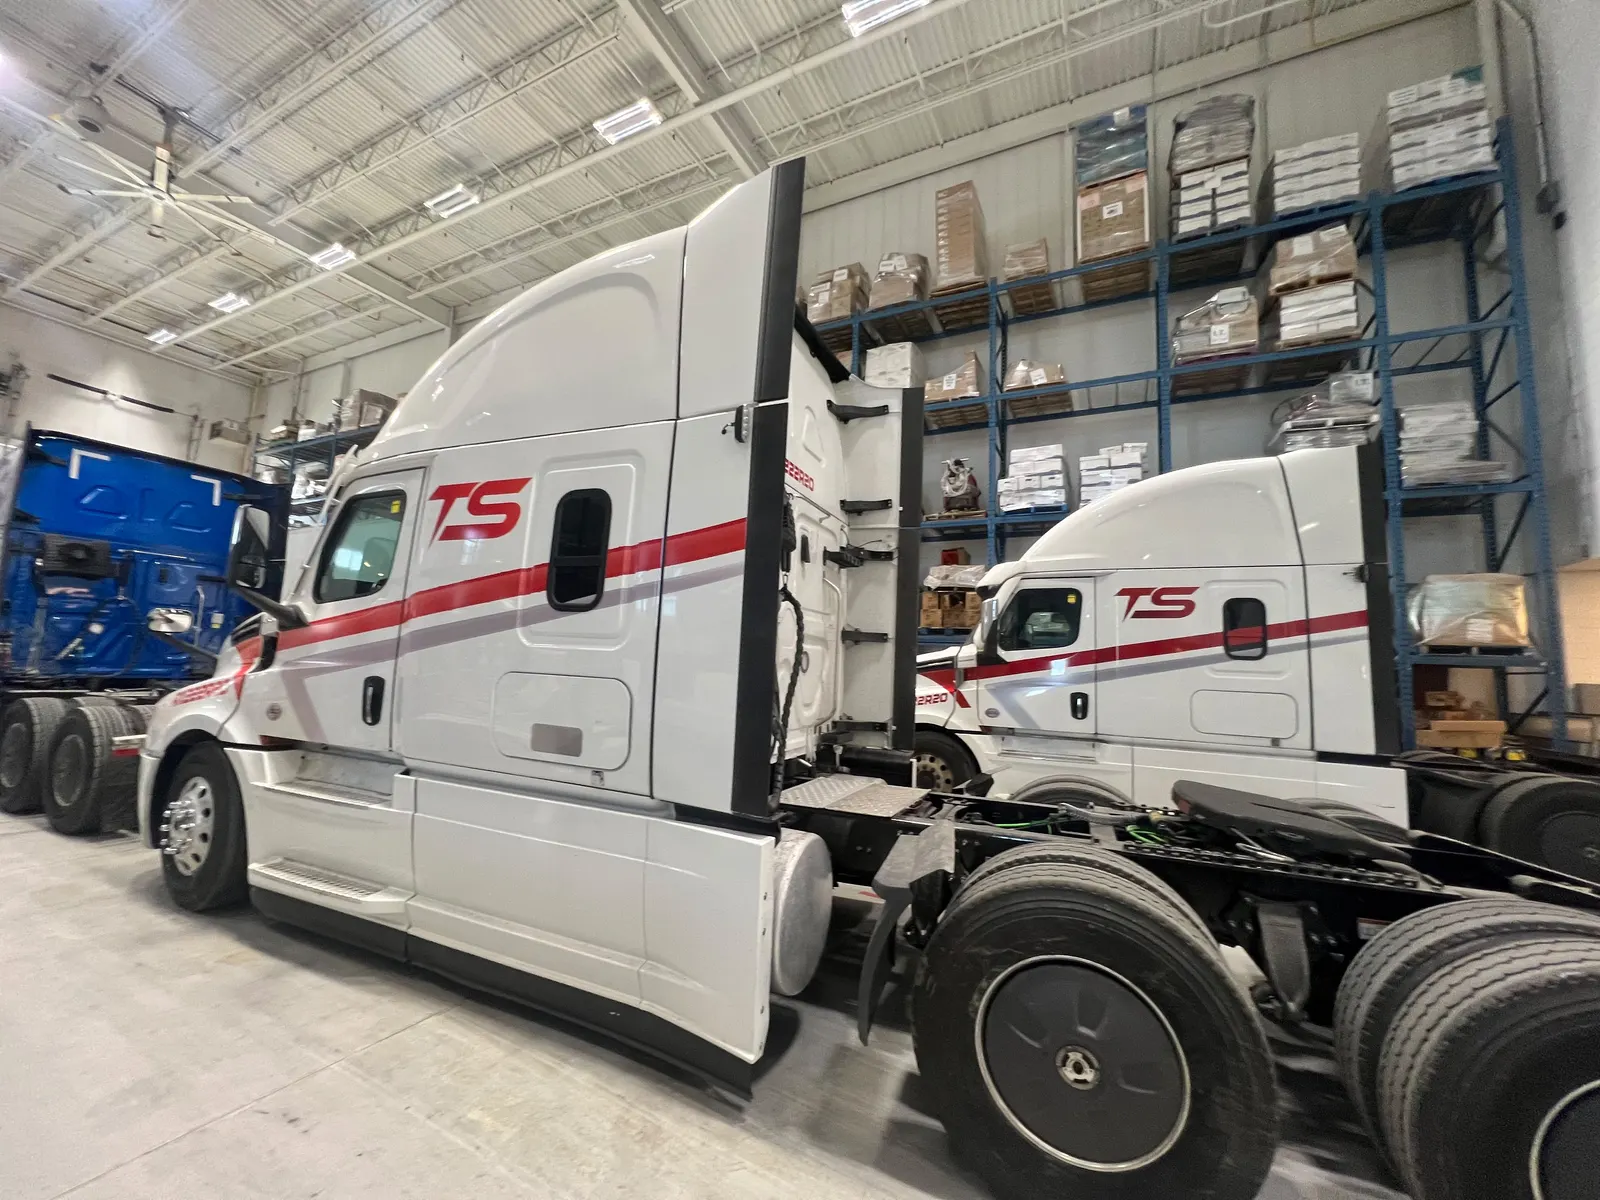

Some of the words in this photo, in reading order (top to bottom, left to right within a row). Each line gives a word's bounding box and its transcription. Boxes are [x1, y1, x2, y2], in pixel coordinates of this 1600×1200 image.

[428, 477, 533, 550] TS
[1113, 586, 1200, 623] TS
[915, 692, 948, 706] 2R20
